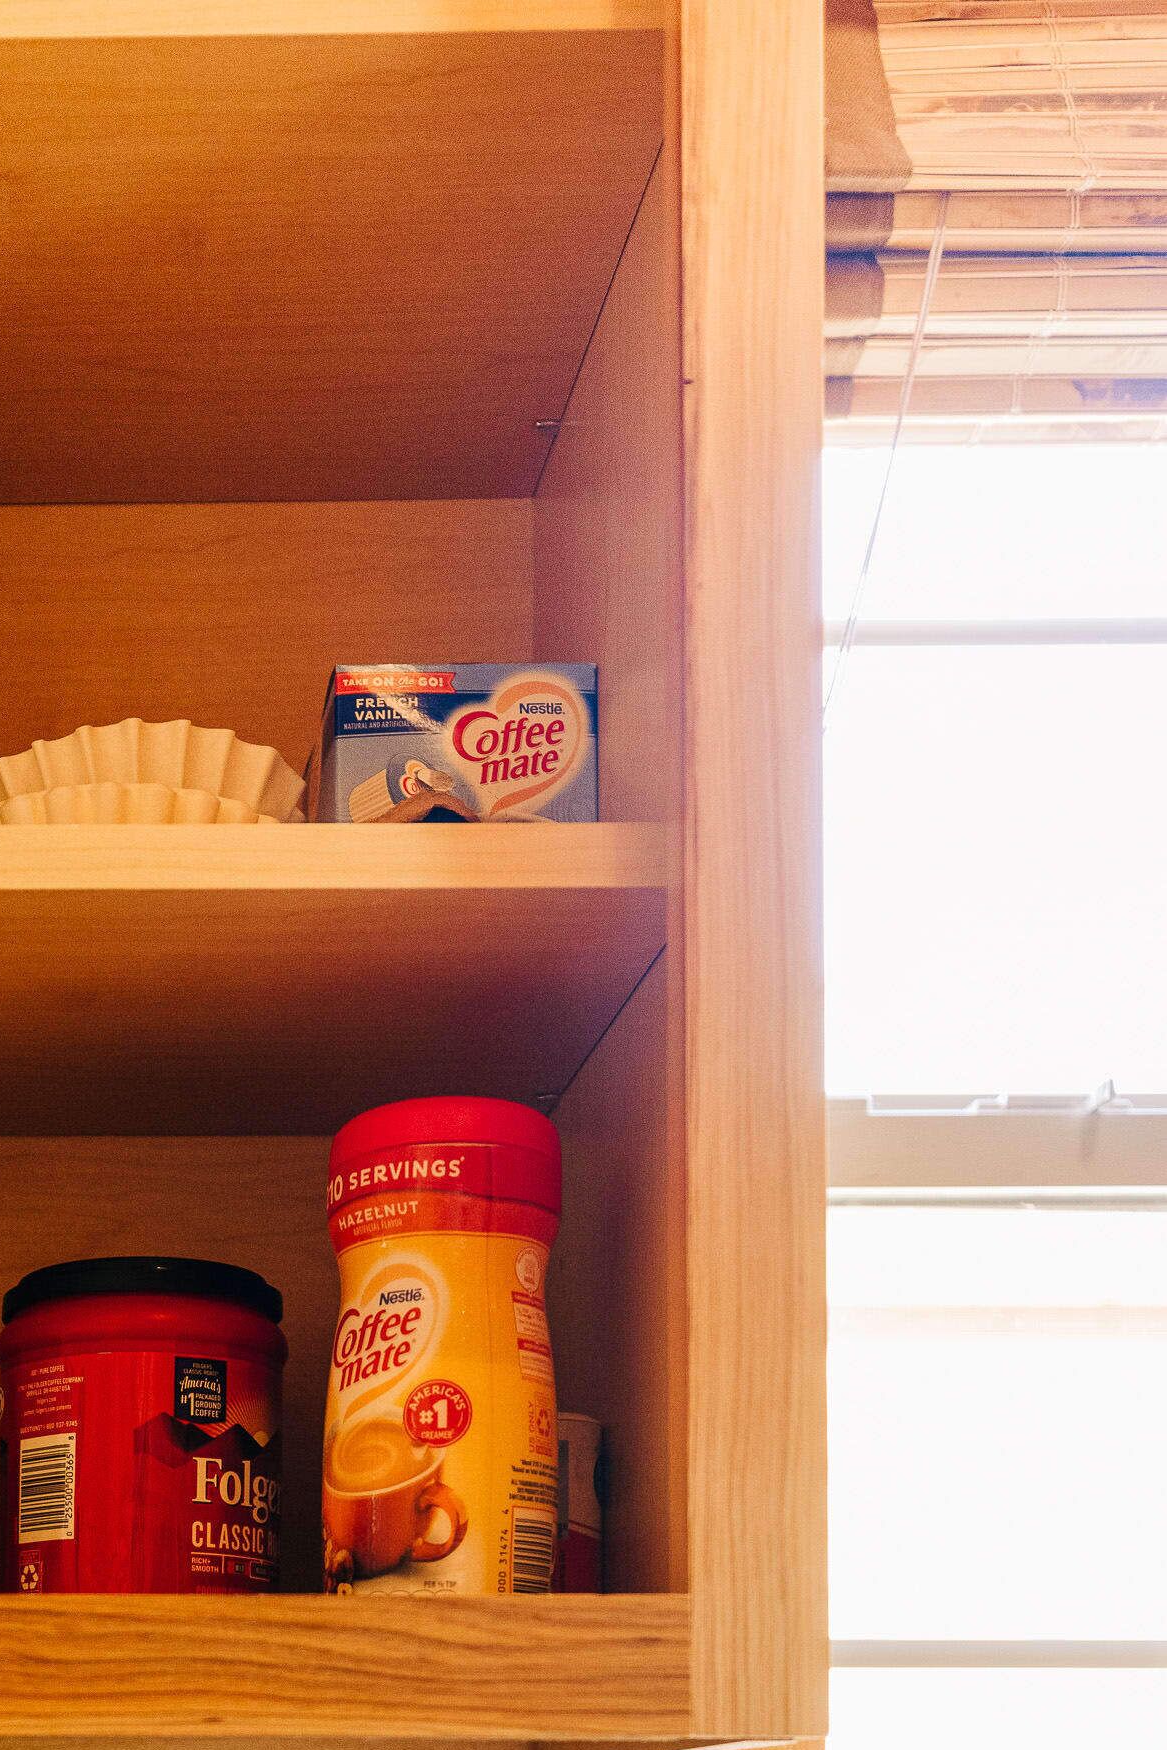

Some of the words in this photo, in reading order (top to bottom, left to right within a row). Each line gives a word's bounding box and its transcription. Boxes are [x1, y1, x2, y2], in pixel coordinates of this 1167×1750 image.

[372, 677, 393, 687] ON
[418, 677, 443, 687] GO!
[343, 722, 368, 730] NATURAL
[452, 711, 565, 762] Coffee
[480, 750, 559, 785] mate
[326, 1174, 343, 1210] 10
[338, 1201, 418, 1231] HAZELNUT
[333, 1307, 422, 1368] Coffee
[339, 1341, 411, 1392] mate
[180, 1376, 221, 1394] America's
[409, 1385, 467, 1412] AMERICA'S
[195, 1401, 222, 1409] GROUND
[195, 1409, 219, 1418] COFFEE
[419, 1399, 448, 1429] #1
[191, 1521, 264, 1554] CLASSIC
[191, 1565, 219, 1573] SMOOTH
